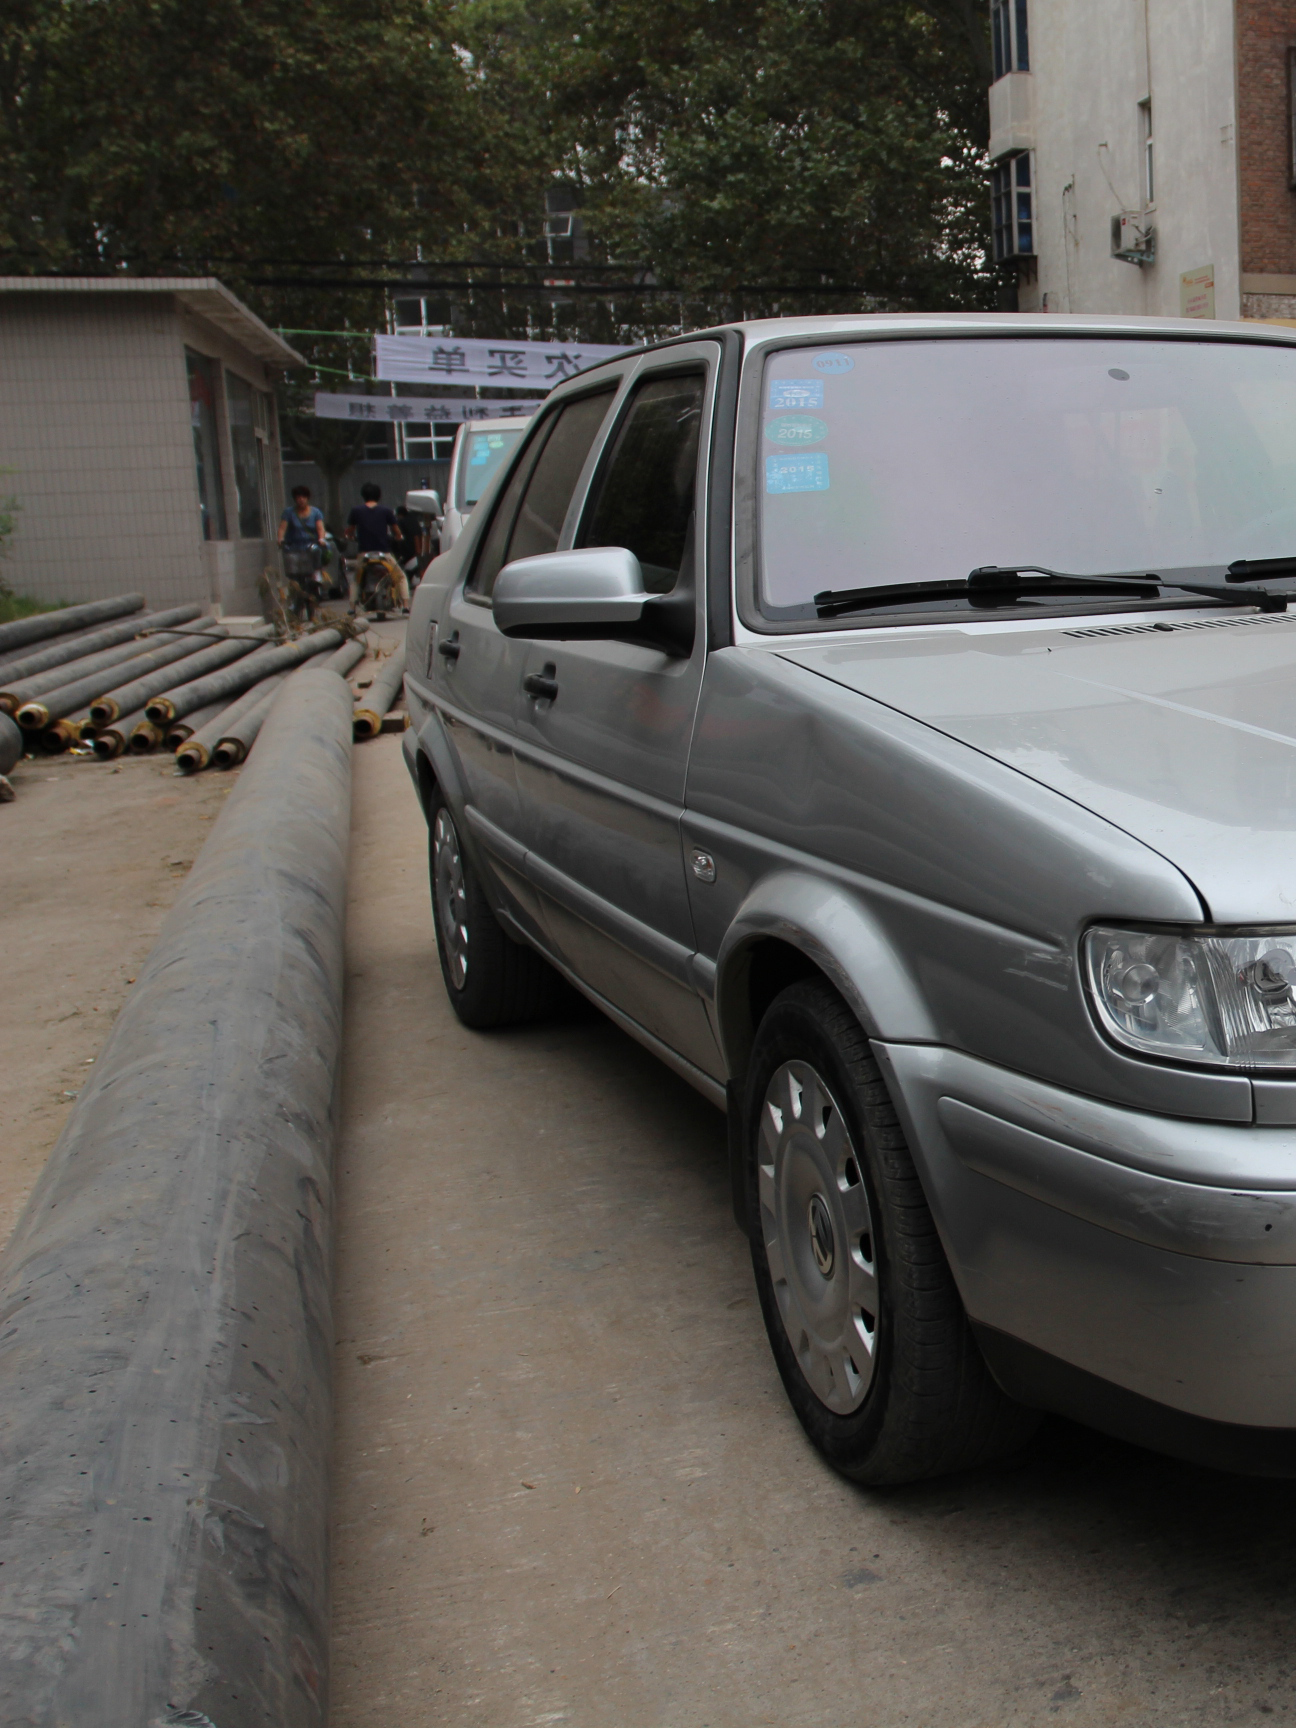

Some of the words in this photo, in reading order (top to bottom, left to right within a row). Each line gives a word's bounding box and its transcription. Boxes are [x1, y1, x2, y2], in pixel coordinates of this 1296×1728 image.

[774, 397, 818, 408] 2015
[777, 428, 813, 439] 2015
[780, 465, 815, 474] 2015
